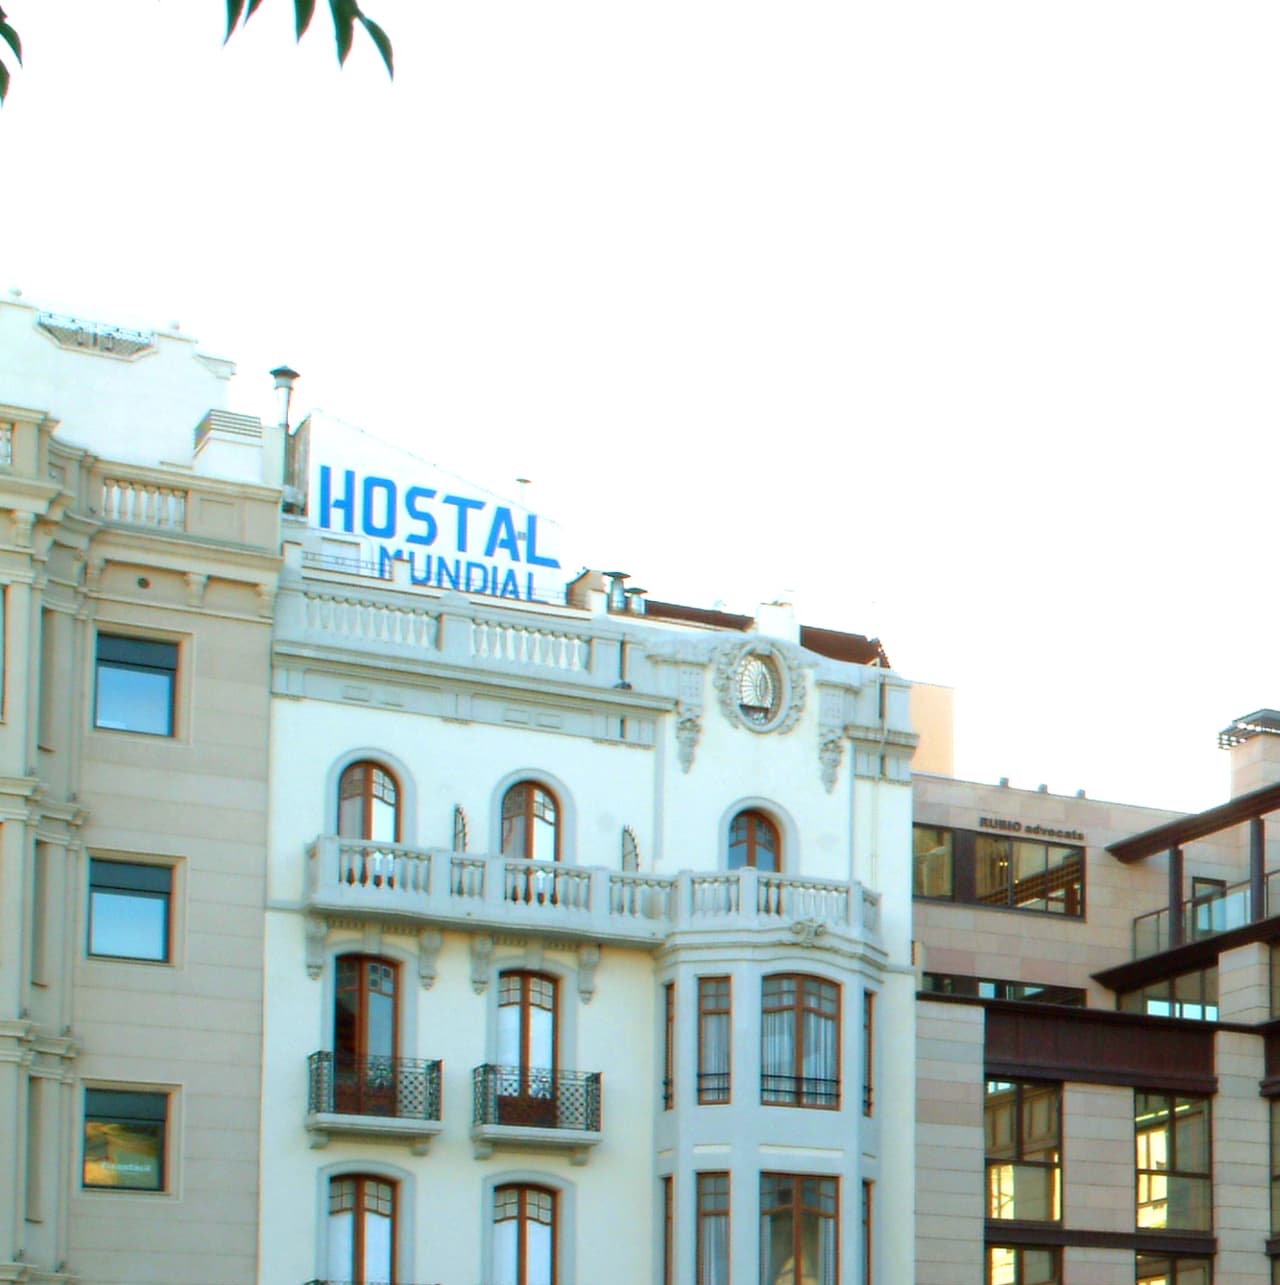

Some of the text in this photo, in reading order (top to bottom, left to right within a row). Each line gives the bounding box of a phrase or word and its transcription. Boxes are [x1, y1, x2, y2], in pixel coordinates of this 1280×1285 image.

[319, 465, 561, 569] HOSTAL
[379, 544, 550, 604] MUNDIAL
[1024, 824, 1084, 841] advocats
